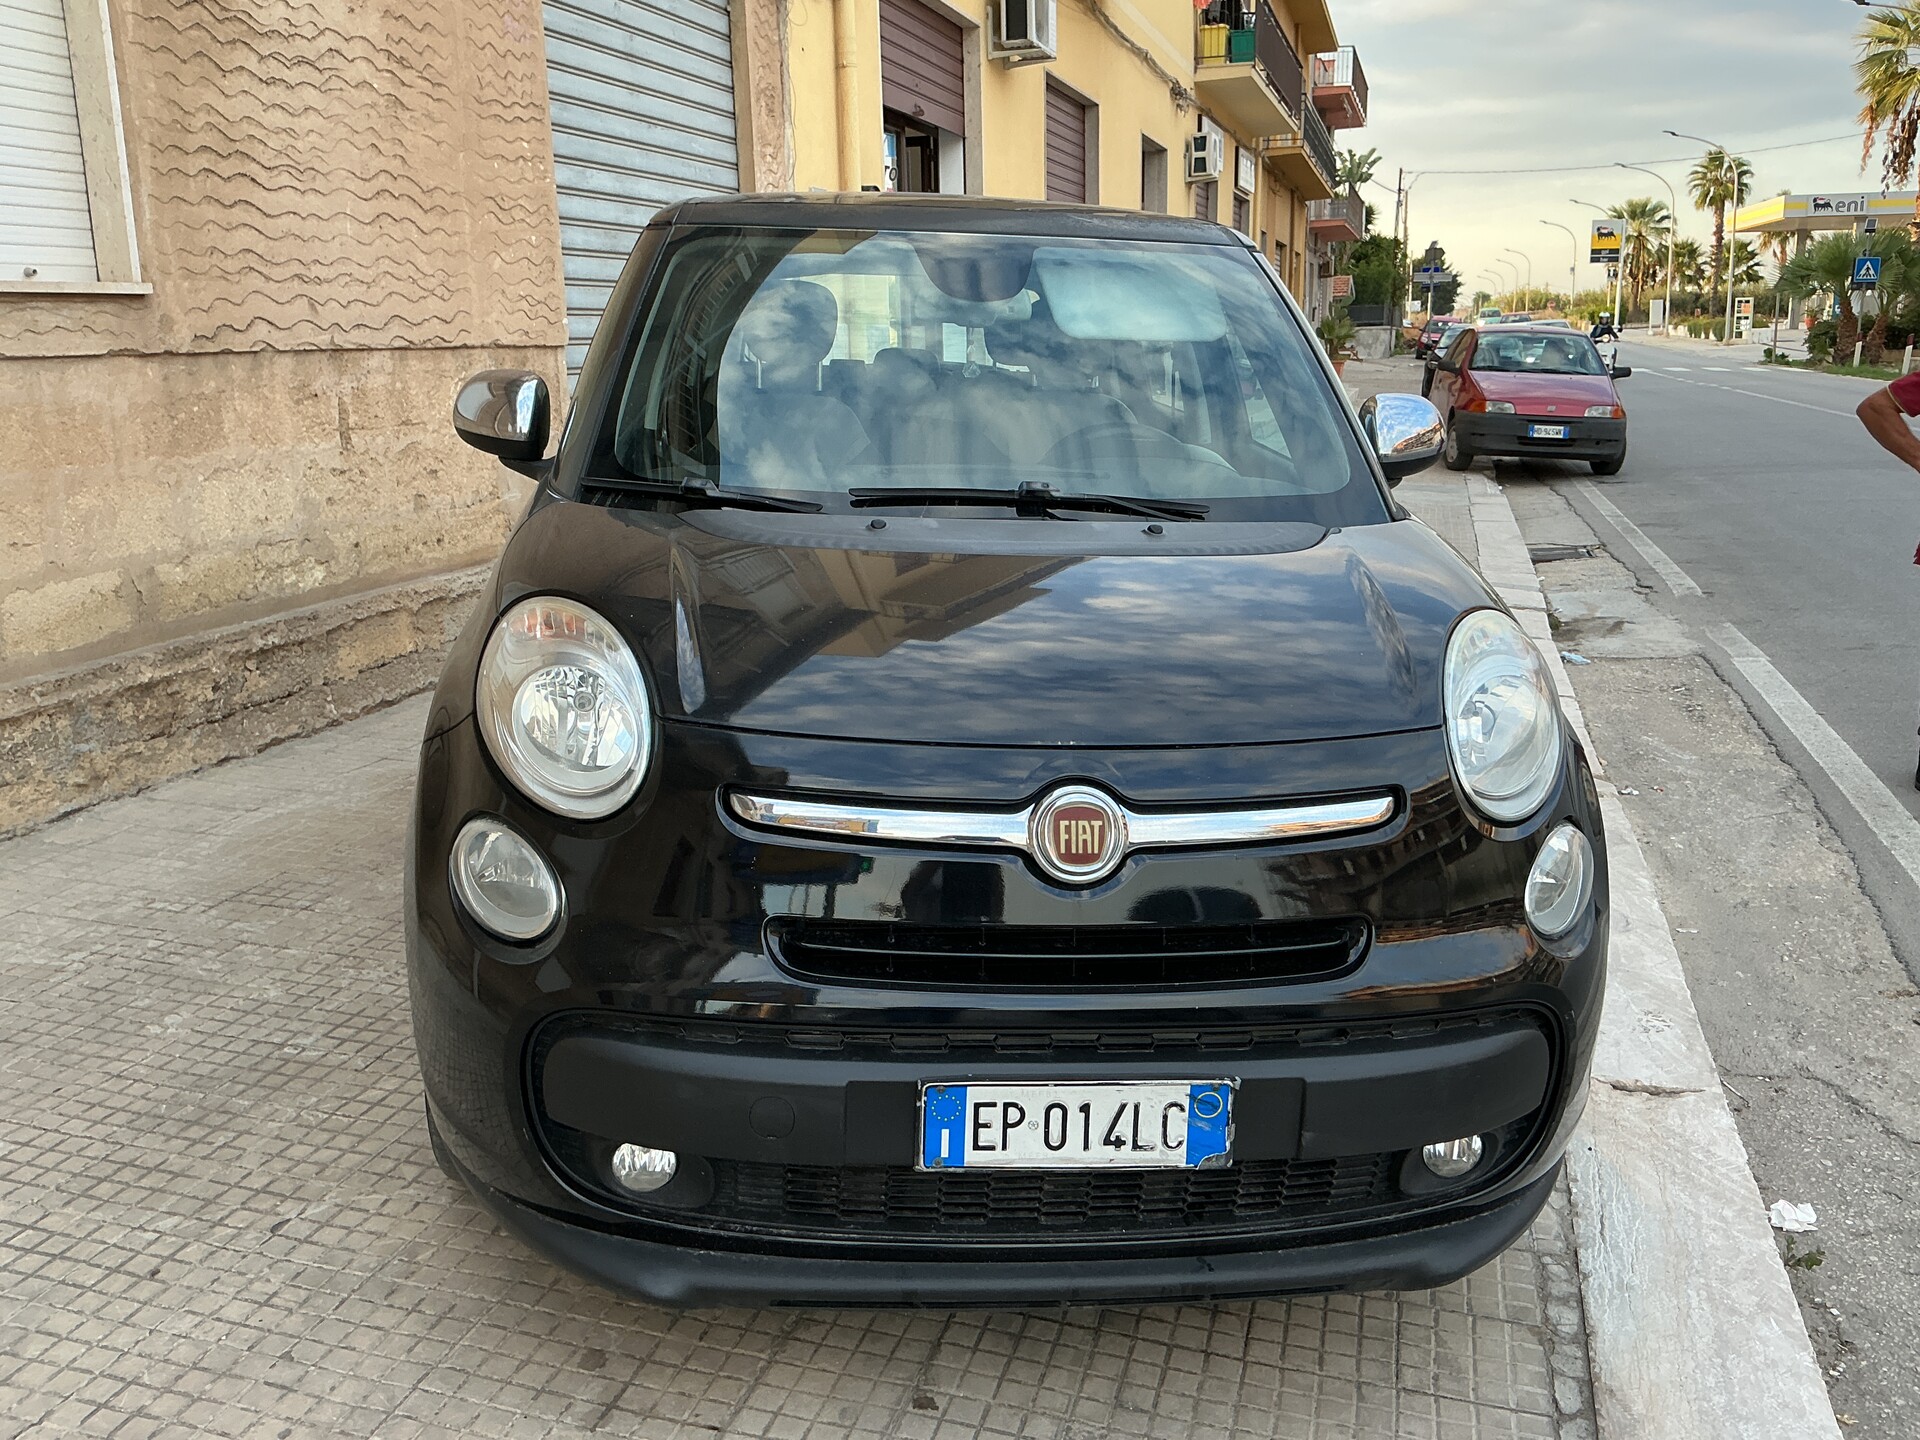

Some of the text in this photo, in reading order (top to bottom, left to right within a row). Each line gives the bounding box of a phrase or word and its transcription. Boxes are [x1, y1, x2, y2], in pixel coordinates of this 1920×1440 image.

[1835, 196, 1865, 213] eni
[1059, 820, 1103, 854] FIAT
[971, 1100, 1187, 1151] EP 014LC
